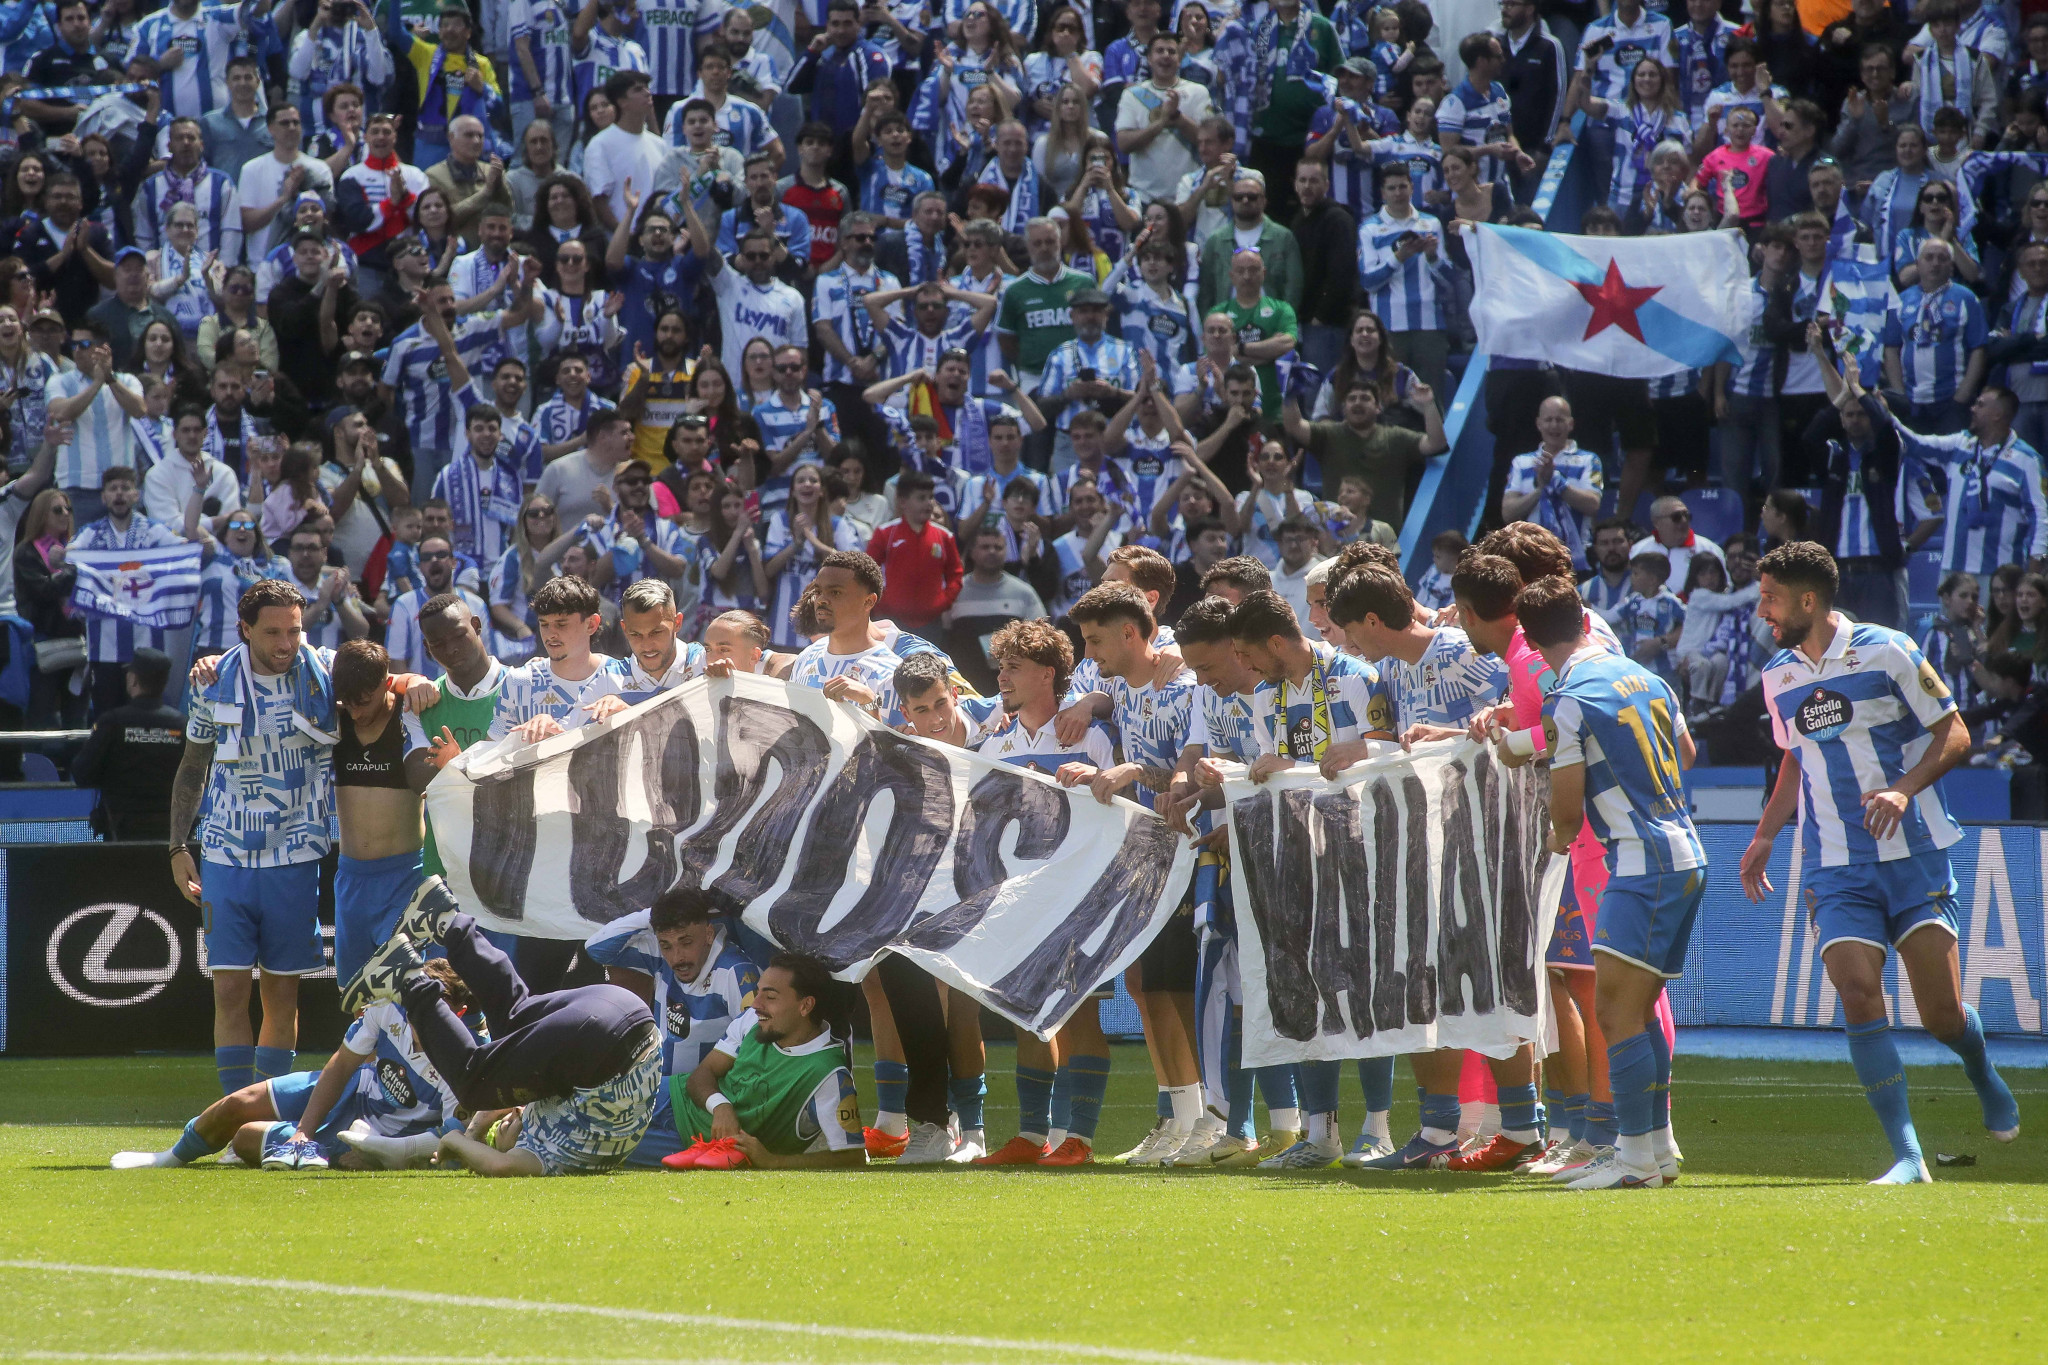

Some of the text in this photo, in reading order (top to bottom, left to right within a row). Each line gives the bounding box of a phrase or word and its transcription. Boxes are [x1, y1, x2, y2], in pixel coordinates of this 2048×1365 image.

[1025, 306, 1073, 328] FEIRAC
[1803, 699, 1842, 719] Estrella
[1806, 711, 1843, 731] Galicia
[124, 728, 170, 737] POLICIA
[124, 735, 181, 745] NACIONAL
[1617, 697, 1682, 796] 14
[346, 762, 391, 772] CATAPULT
[631, 1034, 655, 1059] Kappa
[380, 1072, 405, 1105] Galicia
[382, 1064, 410, 1098] Estrella
